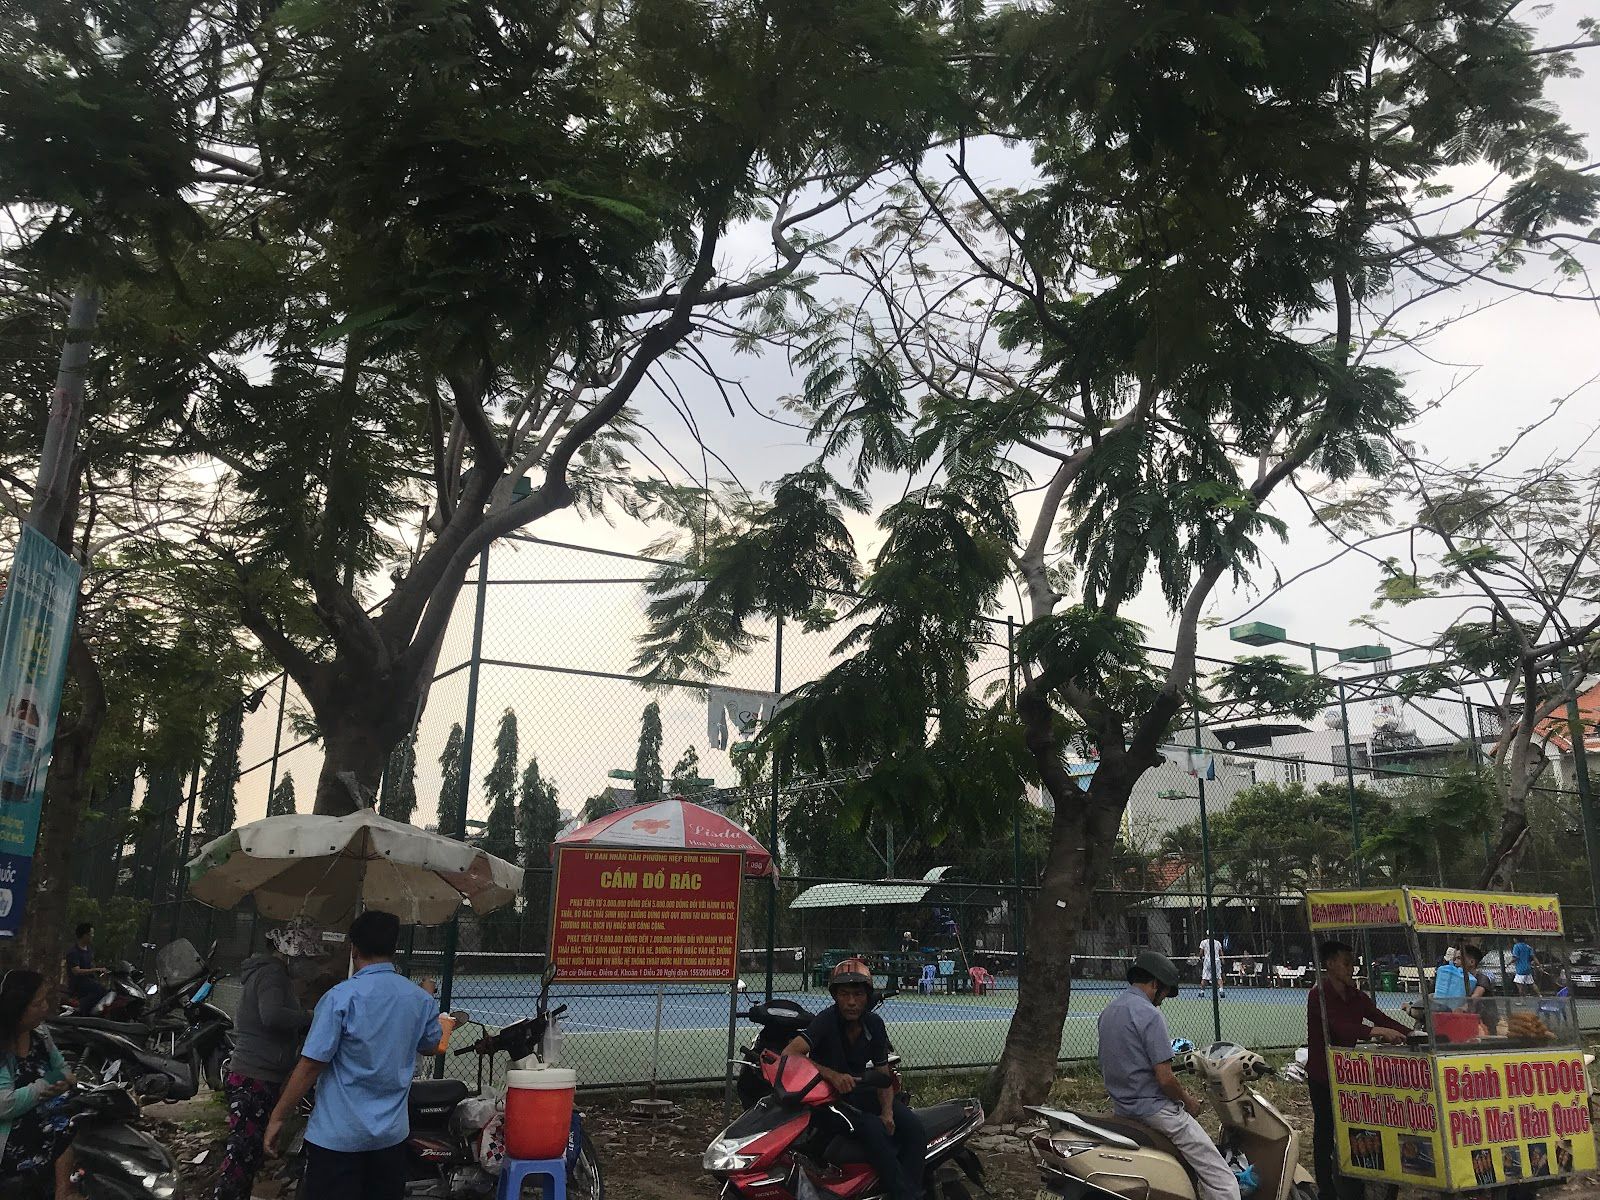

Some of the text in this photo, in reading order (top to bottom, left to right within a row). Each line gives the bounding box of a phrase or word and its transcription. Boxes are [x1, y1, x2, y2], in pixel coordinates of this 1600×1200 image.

[600, 866, 702, 890] CẤM ĐỔ RÁC
[1411, 897, 1444, 926] Bánh
[1443, 899, 1488, 928] HOTDOG
[1538, 902, 1558, 931] Quốc
[1333, 1052, 1433, 1092] Bánh HOTDOG
[1444, 1059, 1586, 1103] Bánh HOTDOG
[1383, 1094, 1407, 1128] Hàn
[1405, 1092, 1437, 1134] Quốc
[1484, 1105, 1518, 1143] Mai
[1518, 1103, 1550, 1140] Hàn
[1552, 1095, 1590, 1141] Quốc
